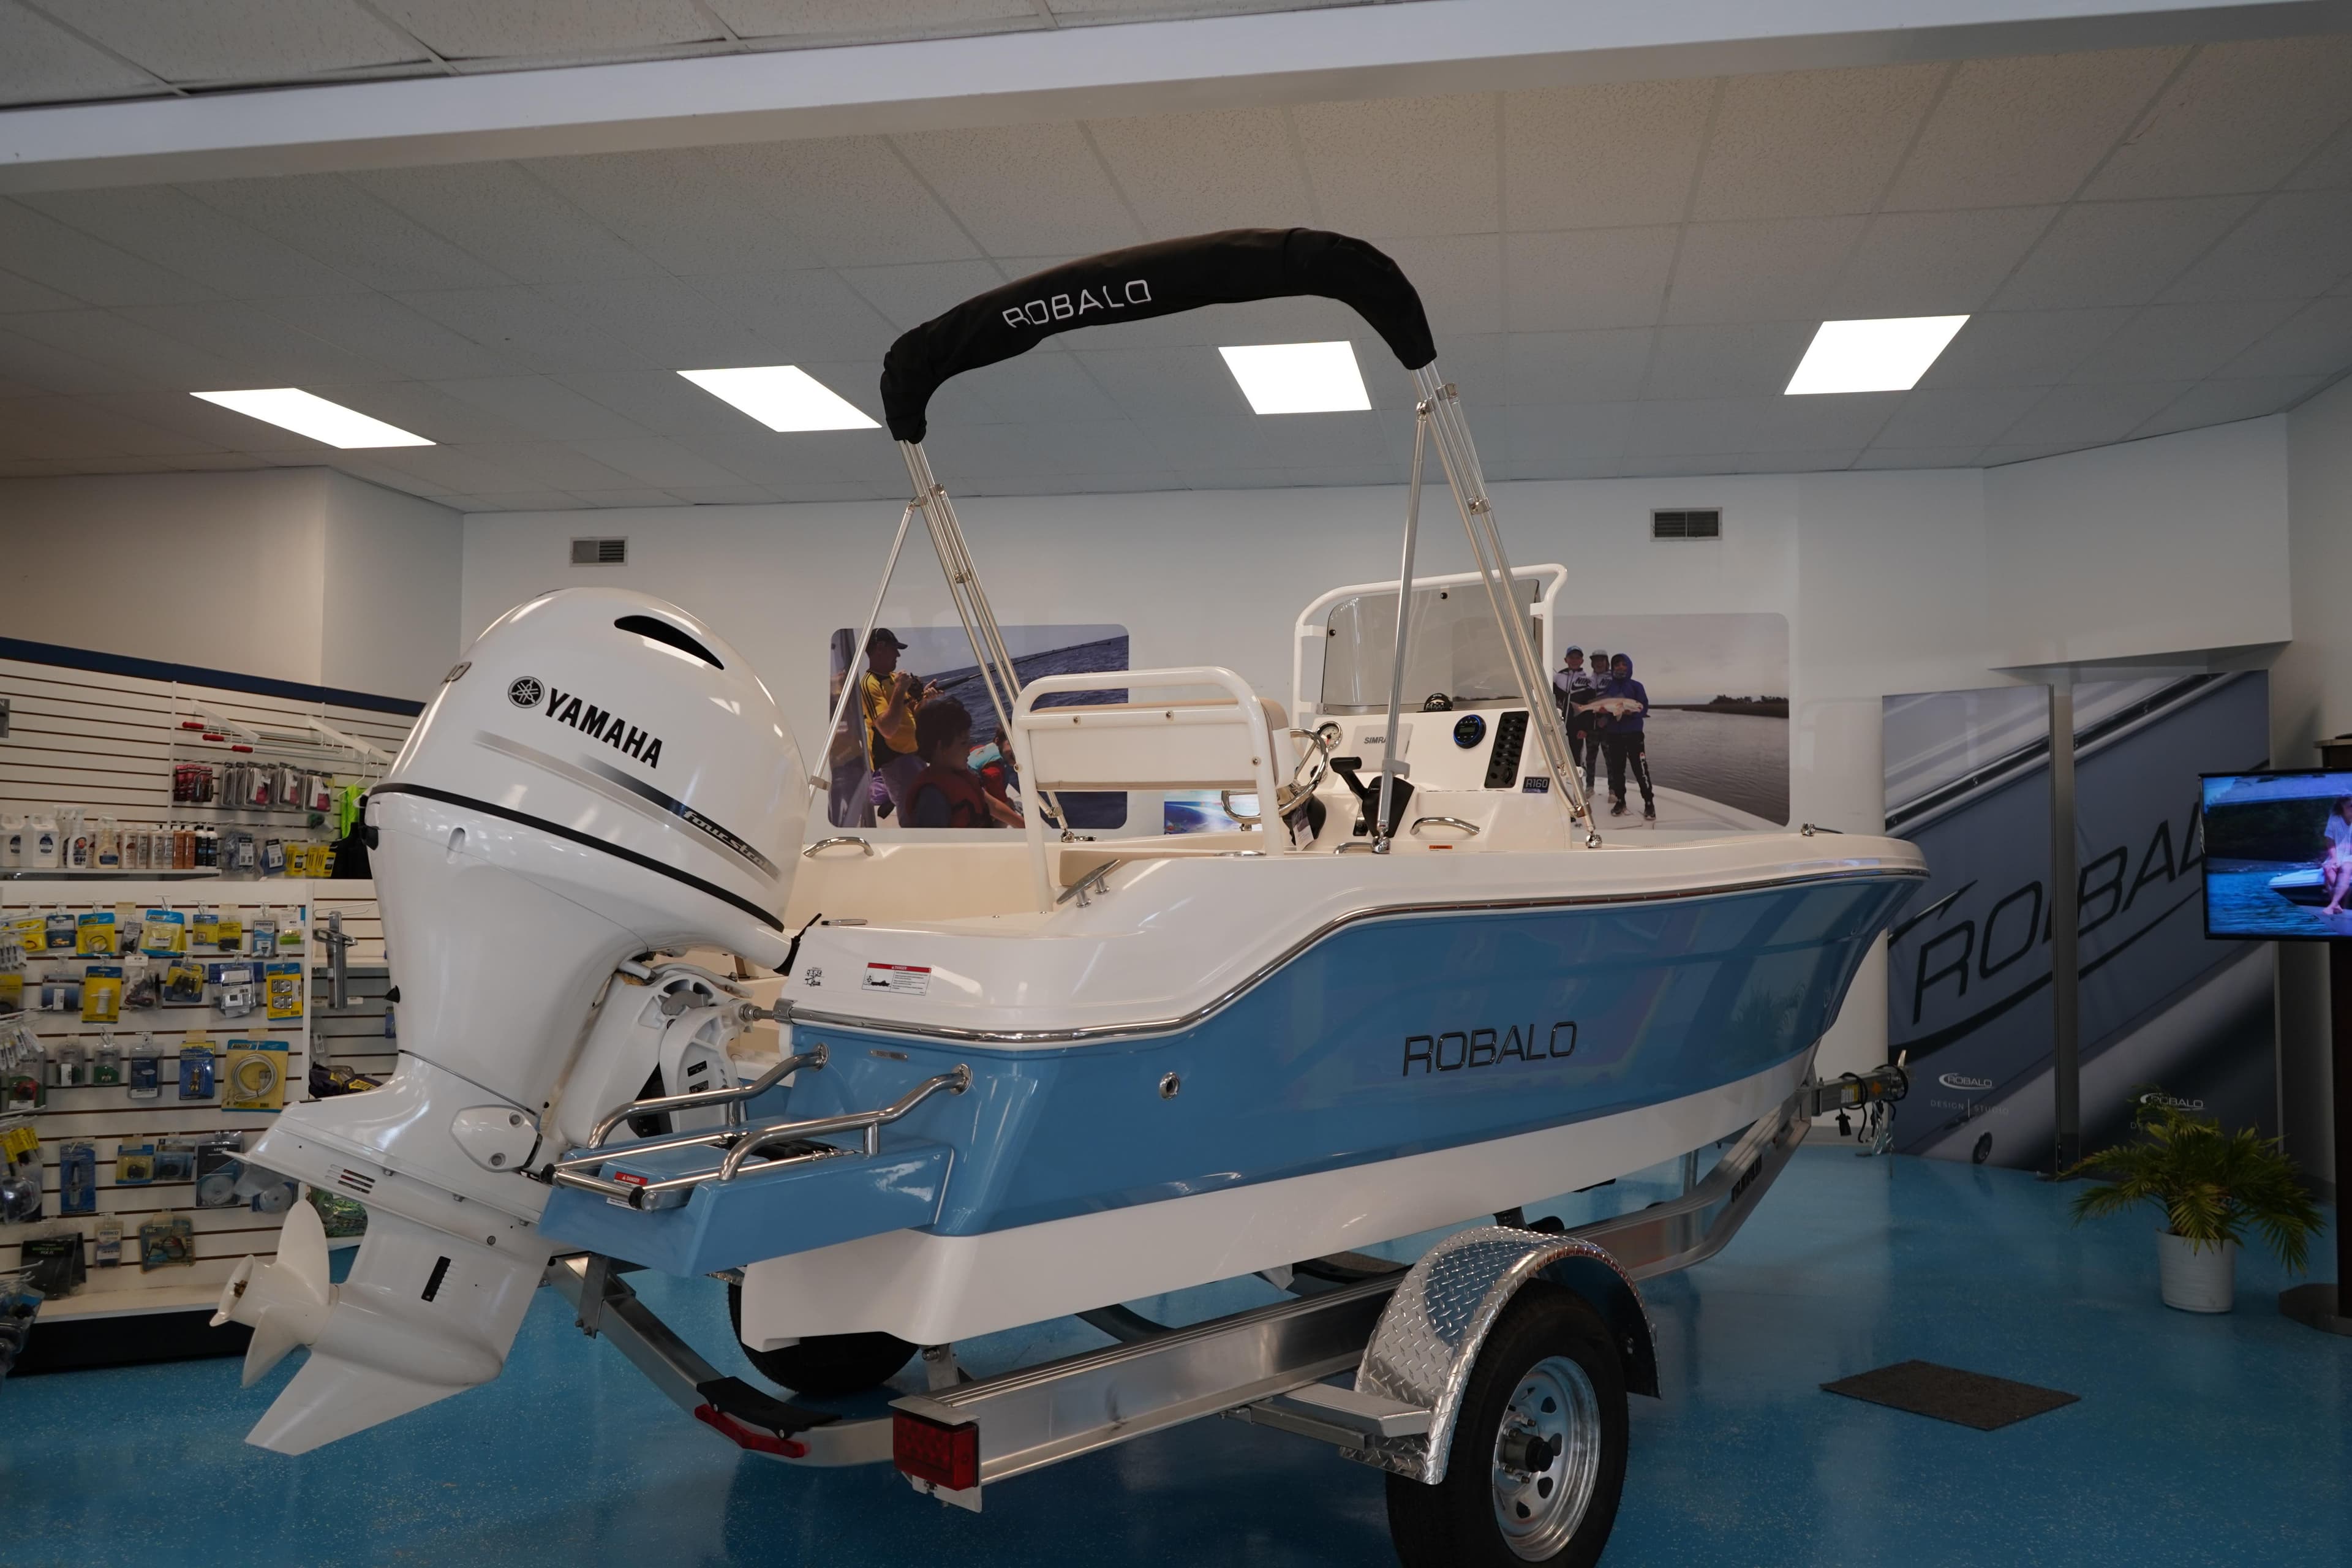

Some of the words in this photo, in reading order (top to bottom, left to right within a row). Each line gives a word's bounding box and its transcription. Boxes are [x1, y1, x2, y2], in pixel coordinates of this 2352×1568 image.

[1002, 279, 1152, 328] ROBALO
[545, 688, 663, 769] YAMAHA
[1526, 777, 1549, 789] R160
[1912, 801, 2204, 1025] ROBAL
[1403, 1020, 1578, 1077] ROBALO
[1930, 1098, 1964, 1110] DESIGN
[1948, 1076, 1992, 1088] ROBALO
